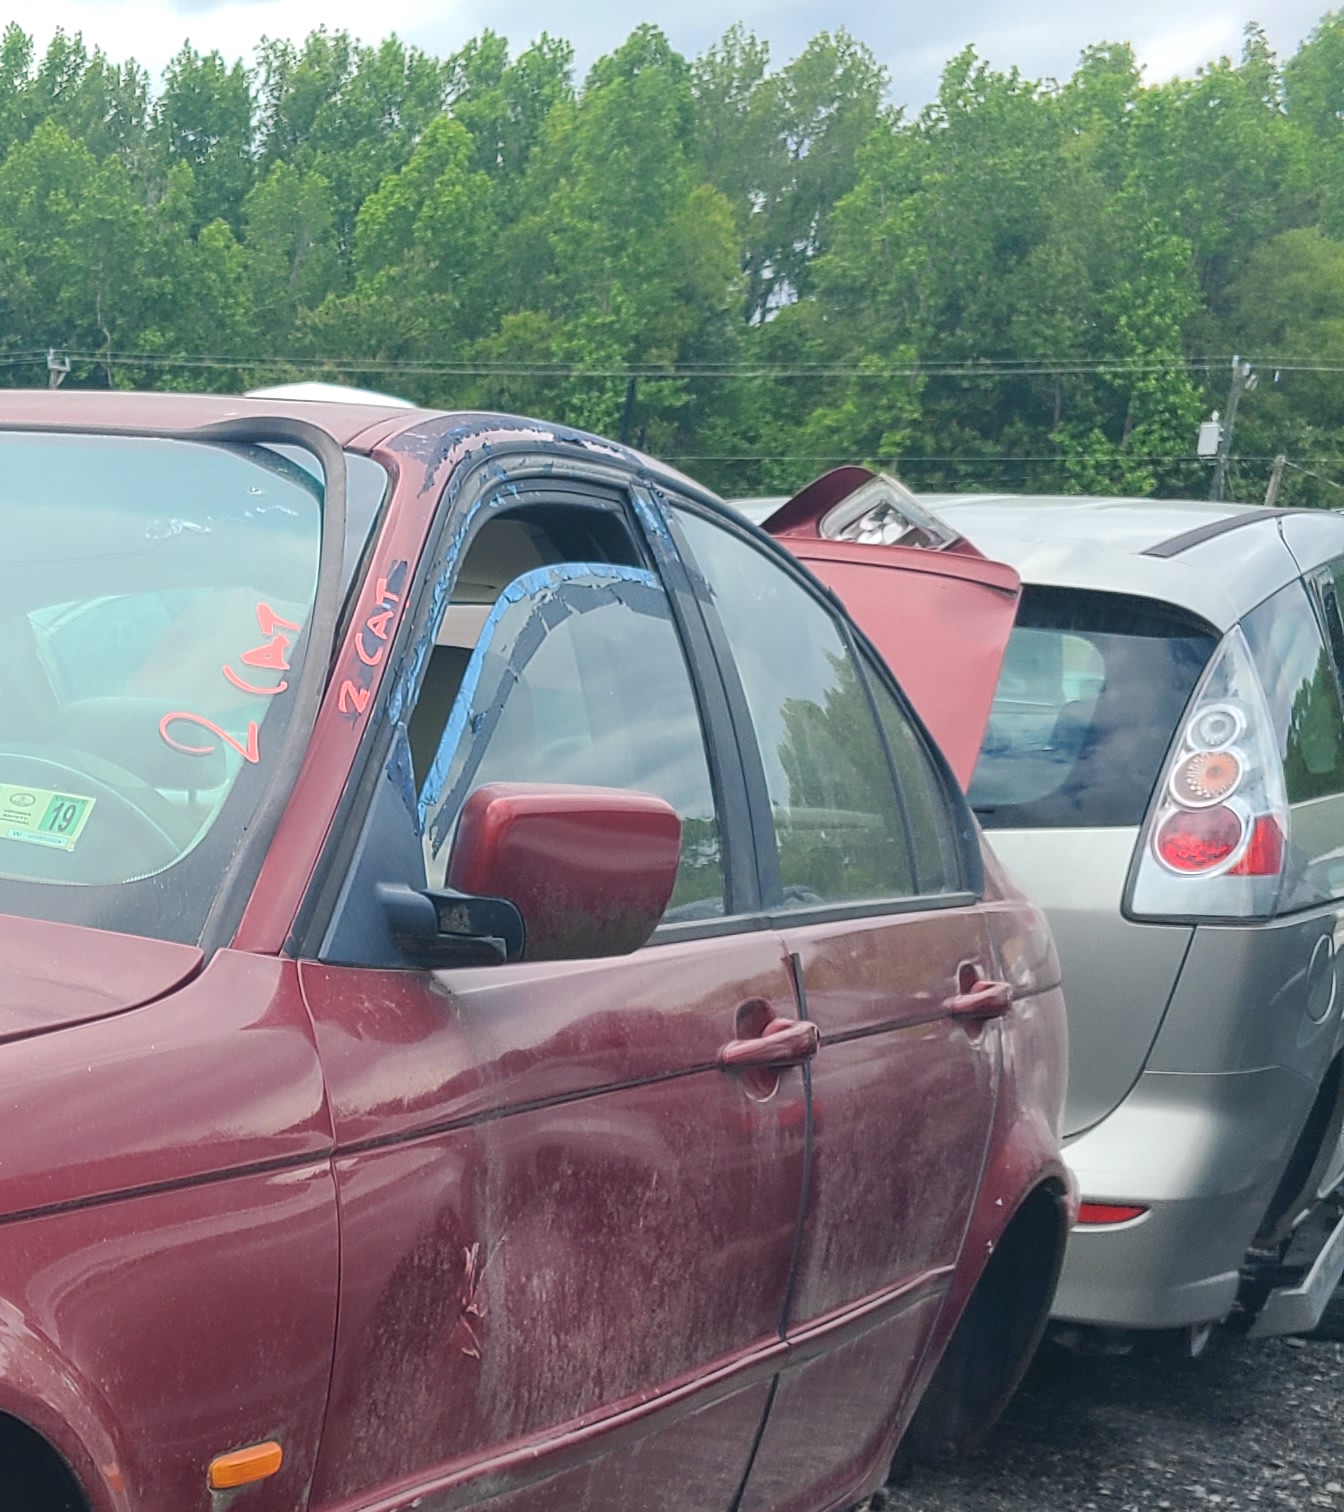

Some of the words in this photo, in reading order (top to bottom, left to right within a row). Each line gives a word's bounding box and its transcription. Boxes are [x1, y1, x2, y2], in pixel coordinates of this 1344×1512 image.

[159, 711, 259, 764] 2
[222, 602, 301, 695] CAT
[337, 680, 370, 714] 2
[354, 577, 399, 666] CAT
[47, 802, 77, 833] 19
